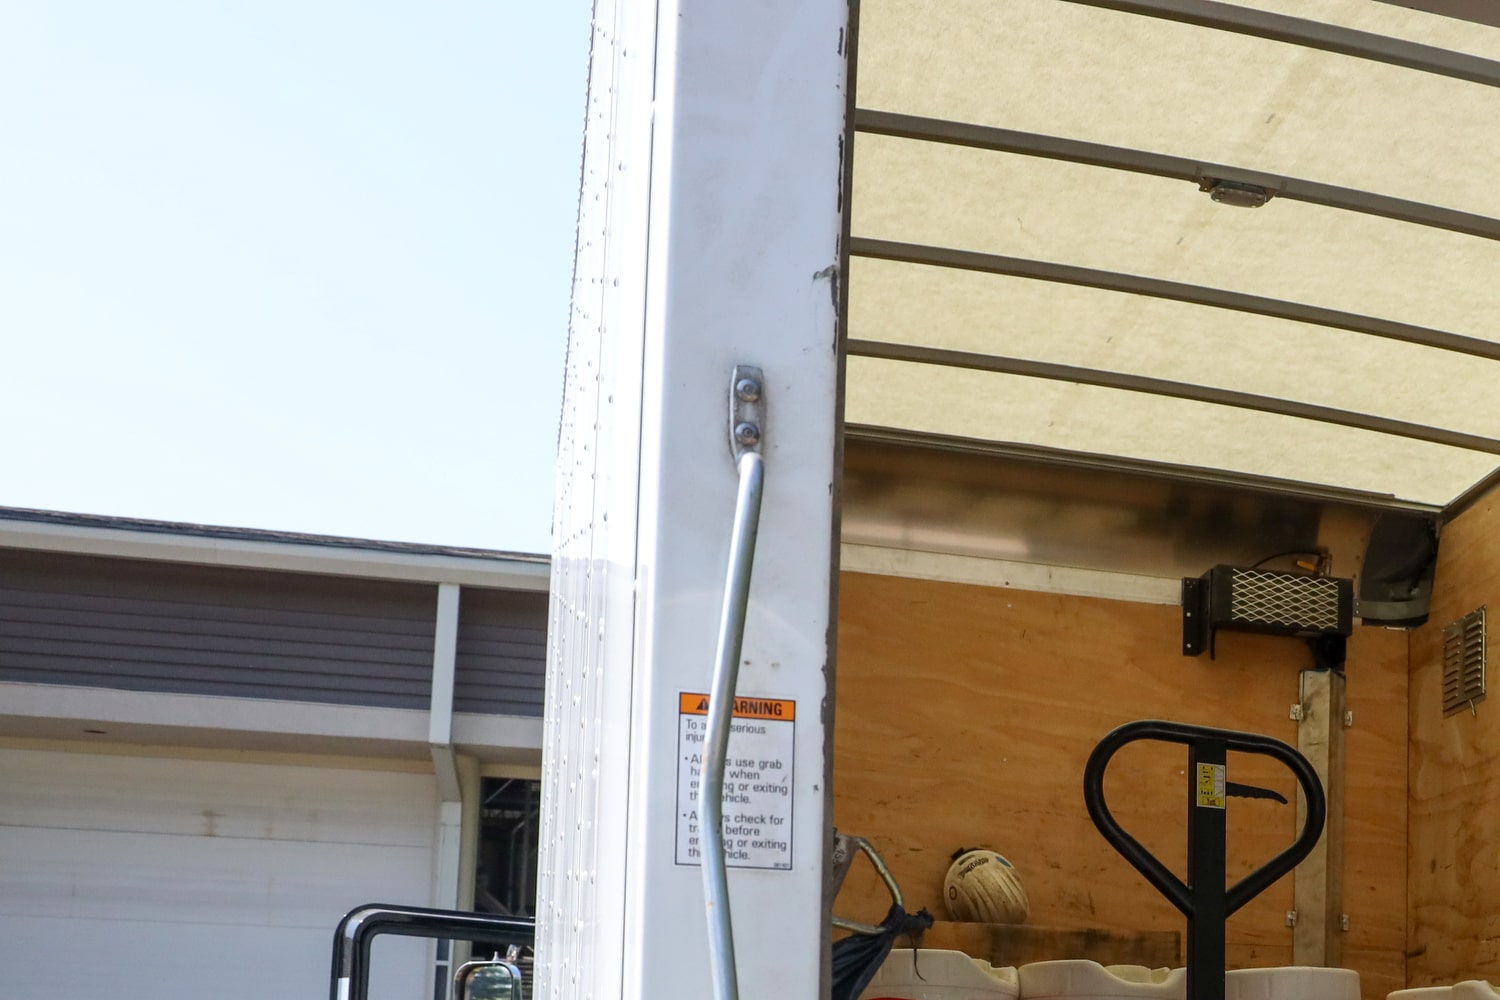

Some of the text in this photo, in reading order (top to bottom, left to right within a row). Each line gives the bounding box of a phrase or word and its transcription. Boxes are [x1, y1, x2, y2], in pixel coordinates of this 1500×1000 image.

[733, 701, 782, 716] ARNING
[686, 719, 697, 729] To
[730, 723, 766, 734] serious
[735, 759, 782, 770] use grab
[729, 769, 760, 780] when
[738, 782, 788, 796] or exiting
[734, 813, 767, 824] check
[769, 814, 784, 825] for
[725, 825, 760, 836] before
[737, 838, 787, 852] or exiting
